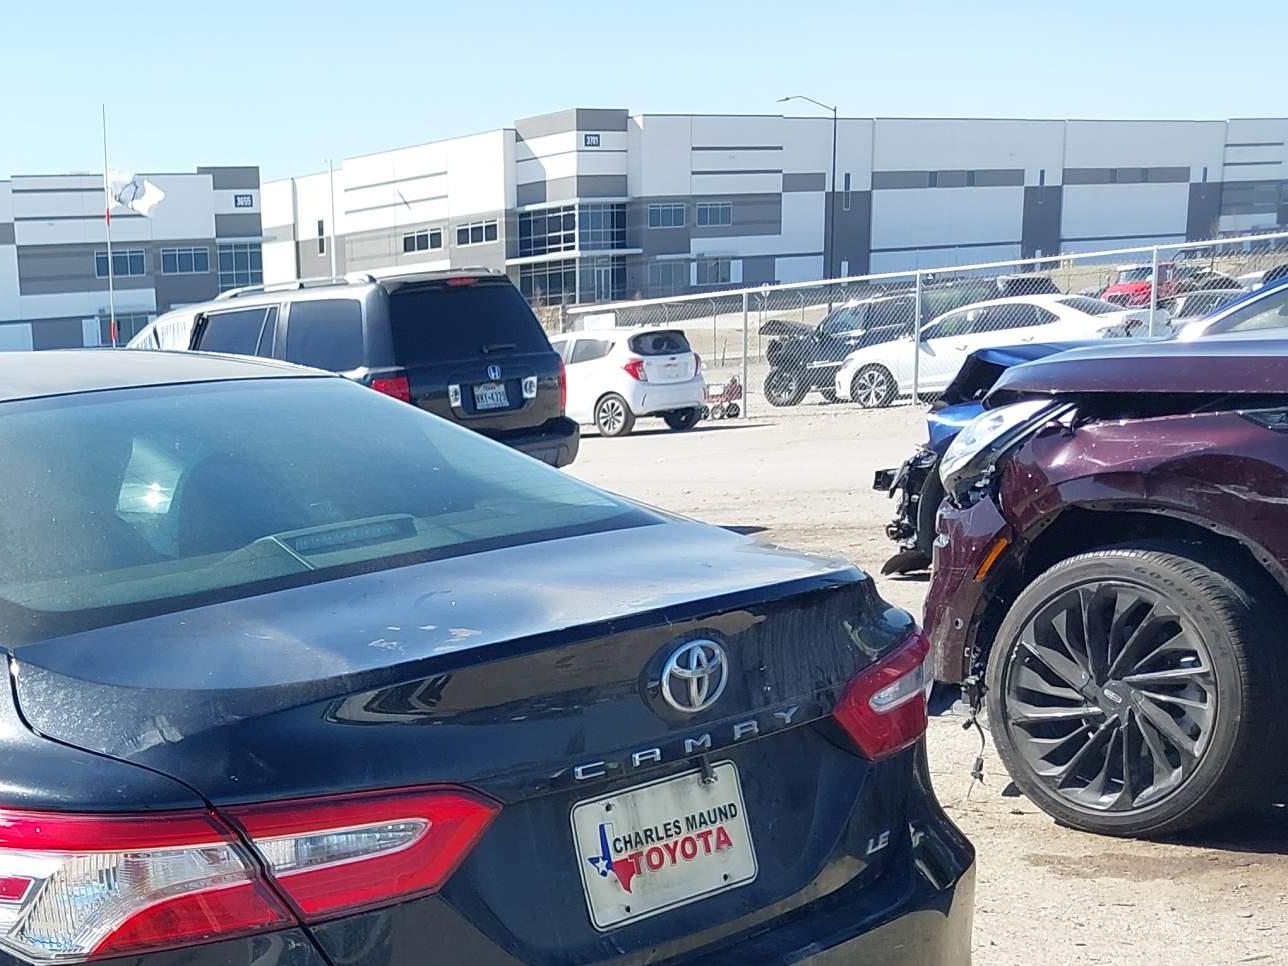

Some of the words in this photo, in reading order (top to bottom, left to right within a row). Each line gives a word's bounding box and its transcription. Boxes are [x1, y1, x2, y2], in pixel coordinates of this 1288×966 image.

[573, 705, 799, 782] CAMRY
[612, 820, 683, 855] CHARLES
[686, 802, 738, 832] MAUND
[629, 825, 734, 876] TOYOTA
[865, 830, 891, 856] LE
